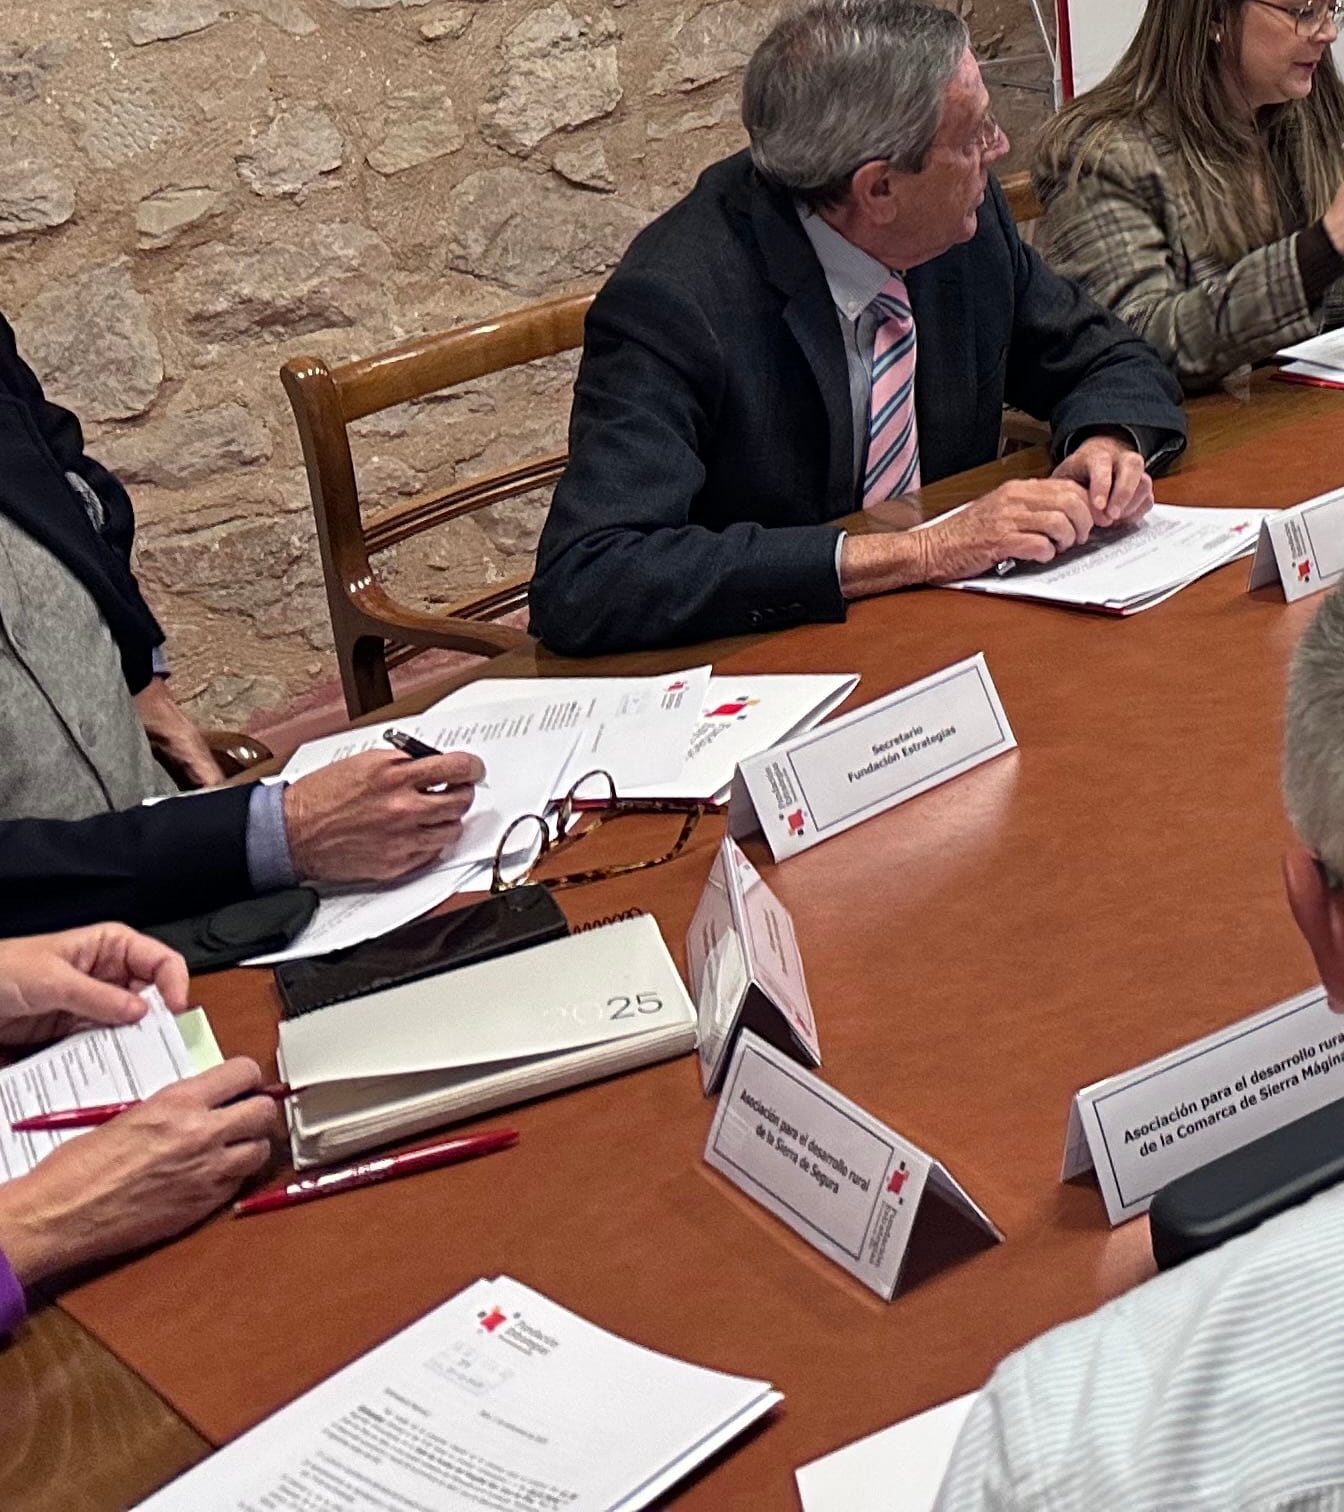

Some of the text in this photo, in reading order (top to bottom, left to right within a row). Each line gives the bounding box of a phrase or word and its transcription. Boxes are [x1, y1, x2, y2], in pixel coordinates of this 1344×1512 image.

[847, 725, 957, 784] Fundación Estrategias
[871, 724, 923, 756] Secretario
[1123, 1101, 1199, 1145] Asociación
[1200, 1086, 1233, 1115] para
[1234, 1074, 1249, 1100] el
[1249, 1046, 1317, 1087] desarrollo
[1138, 1138, 1159, 1159] de
[1160, 1131, 1176, 1150] la
[1176, 1104, 1238, 1141] Comarca
[1239, 1090, 1259, 1110] de
[1258, 1072, 1301, 1102] Sierra
[739, 1088, 872, 1193] Asociación para el desarrollo rural
[755, 1122, 840, 1195] de la Sierra de Segura
